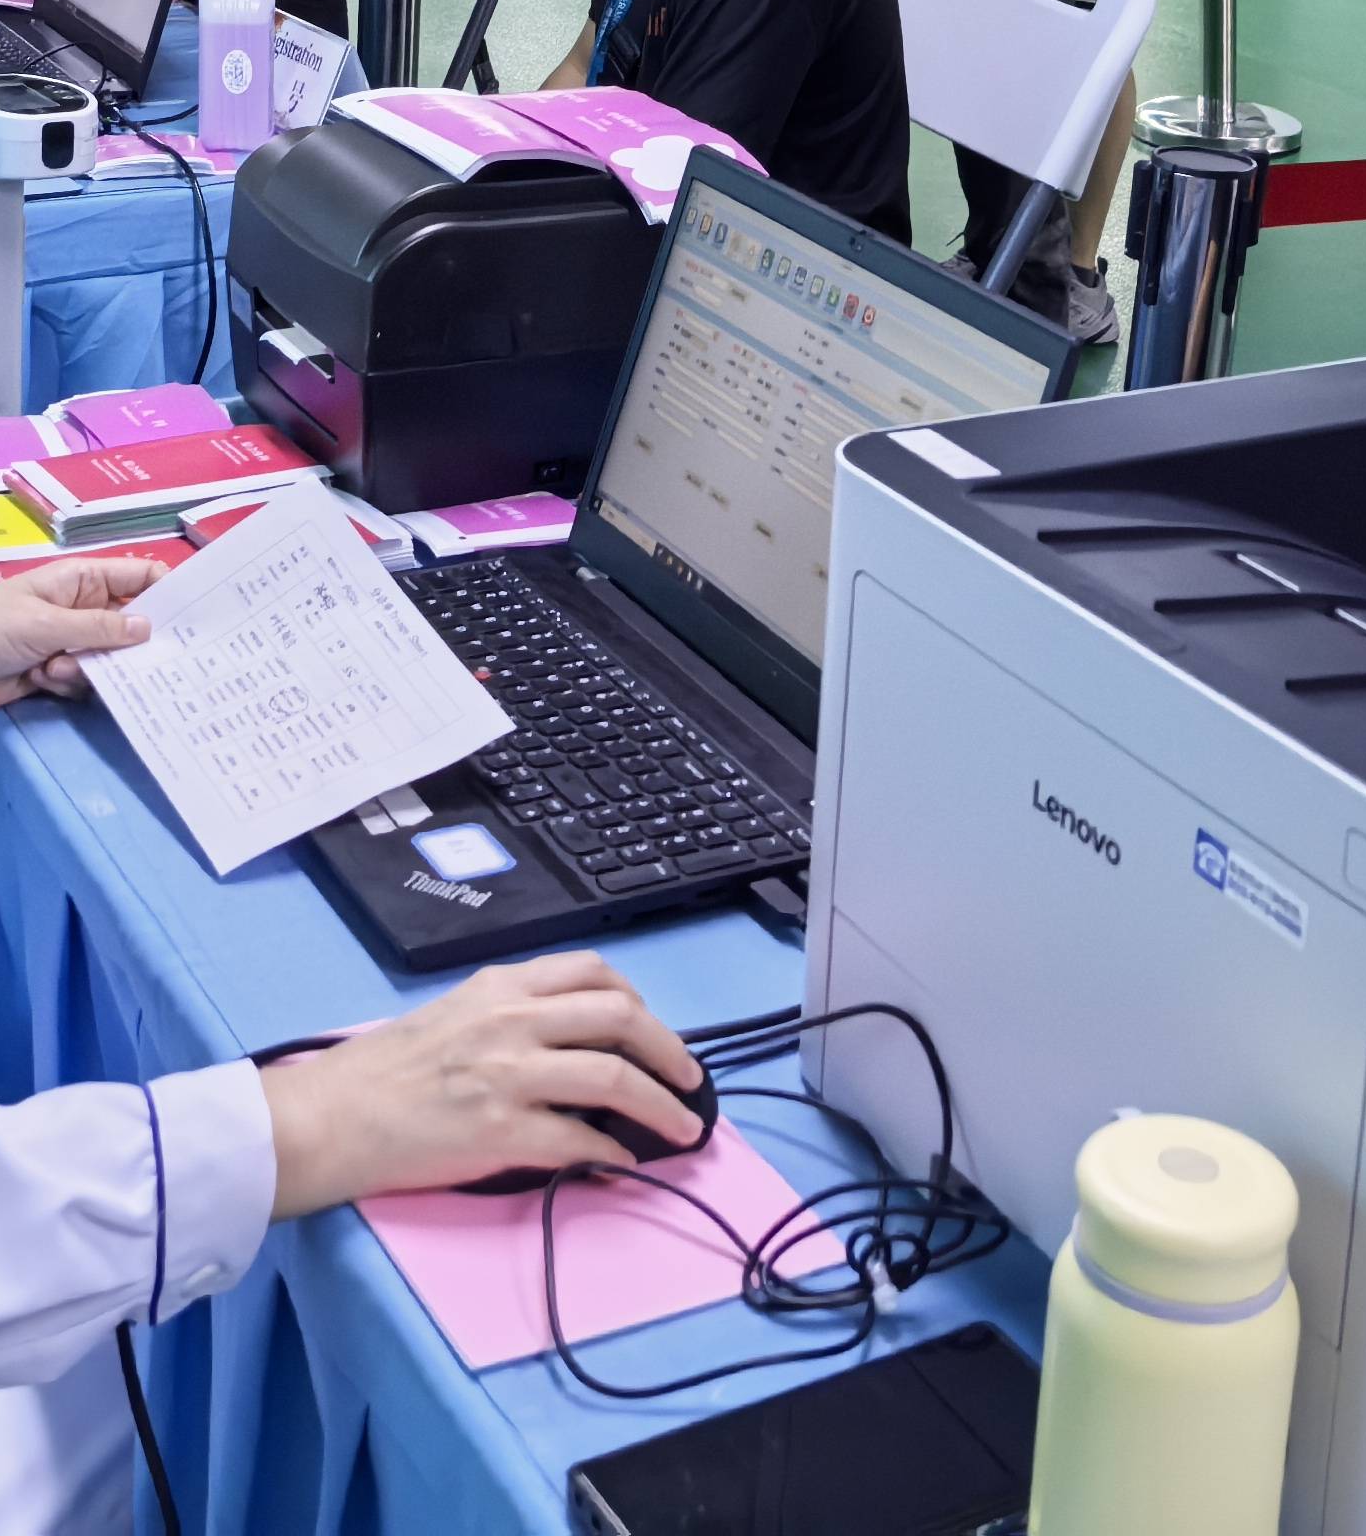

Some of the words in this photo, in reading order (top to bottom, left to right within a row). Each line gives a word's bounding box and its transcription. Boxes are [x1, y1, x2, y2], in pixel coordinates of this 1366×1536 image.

[274, 31, 323, 73] gistration
[1031, 778, 1122, 868] Lenovo
[404, 869, 492, 911] ThinkPad
